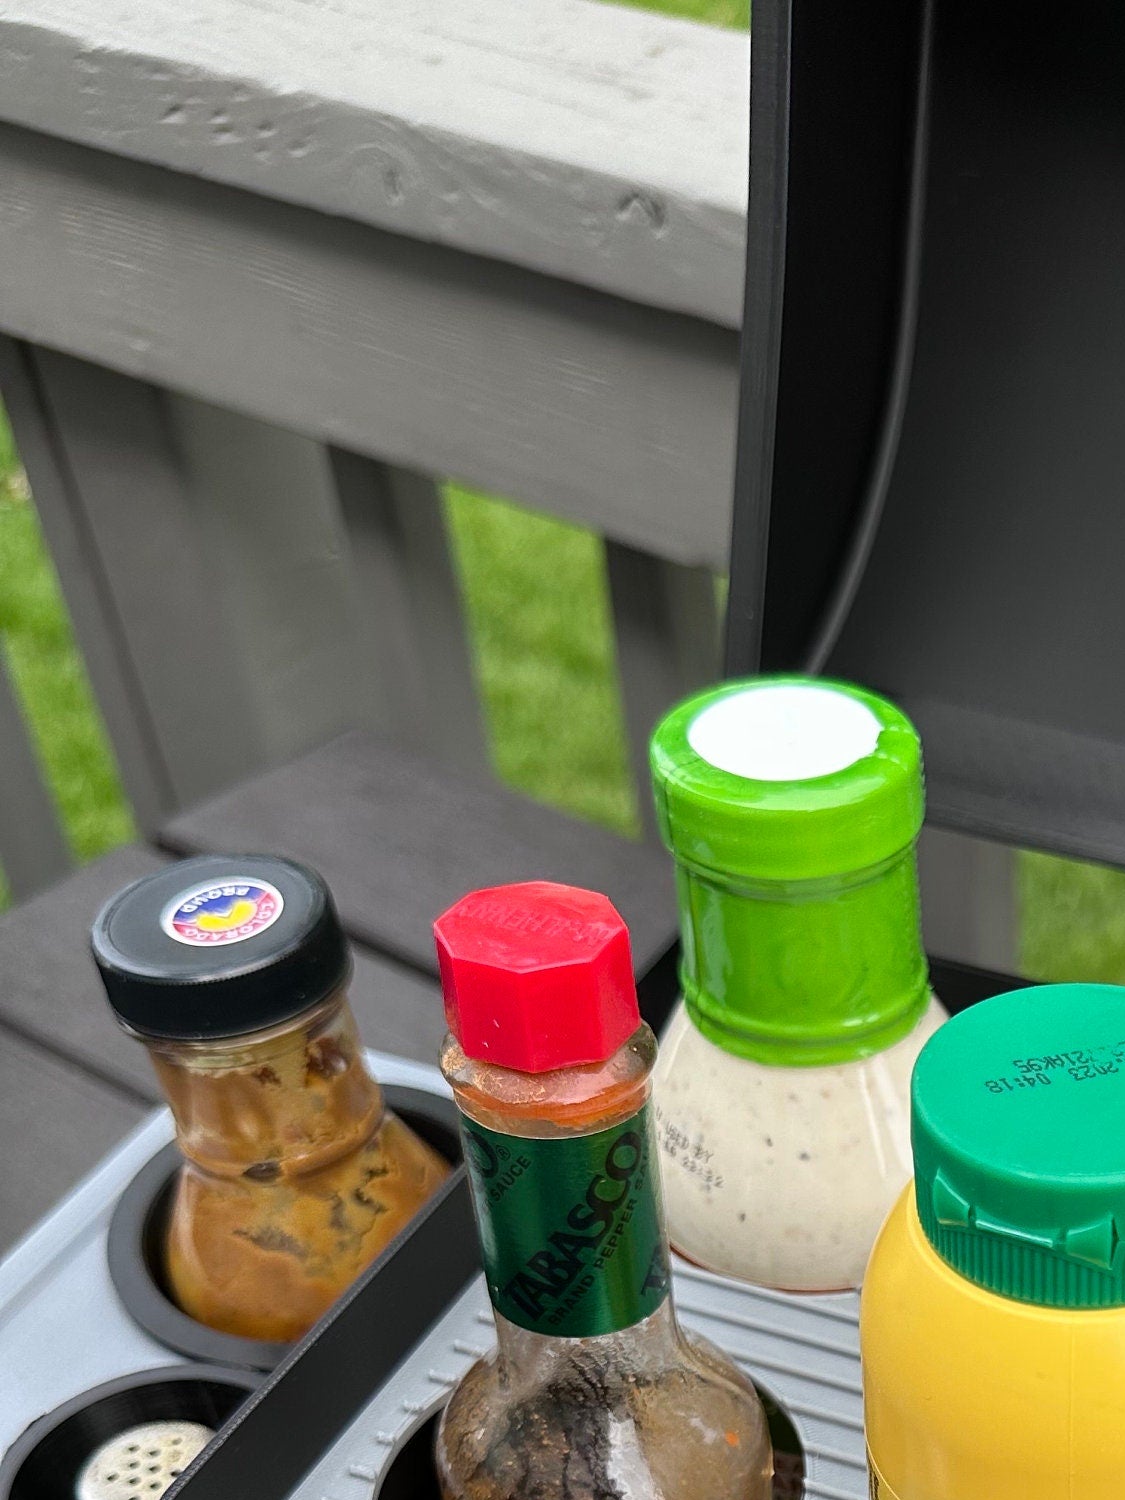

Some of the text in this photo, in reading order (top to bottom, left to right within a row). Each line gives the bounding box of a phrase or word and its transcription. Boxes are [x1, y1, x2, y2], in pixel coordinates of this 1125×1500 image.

[180, 886, 250, 912] PROUD
[182, 902, 275, 941] COLORADO
[984, 1073, 1052, 1093] 04:18
[490, 1155, 532, 1203] SAUCE
[500, 1131, 642, 1323] TABASCO
[548, 1199, 638, 1326] BRAND PEPPER
